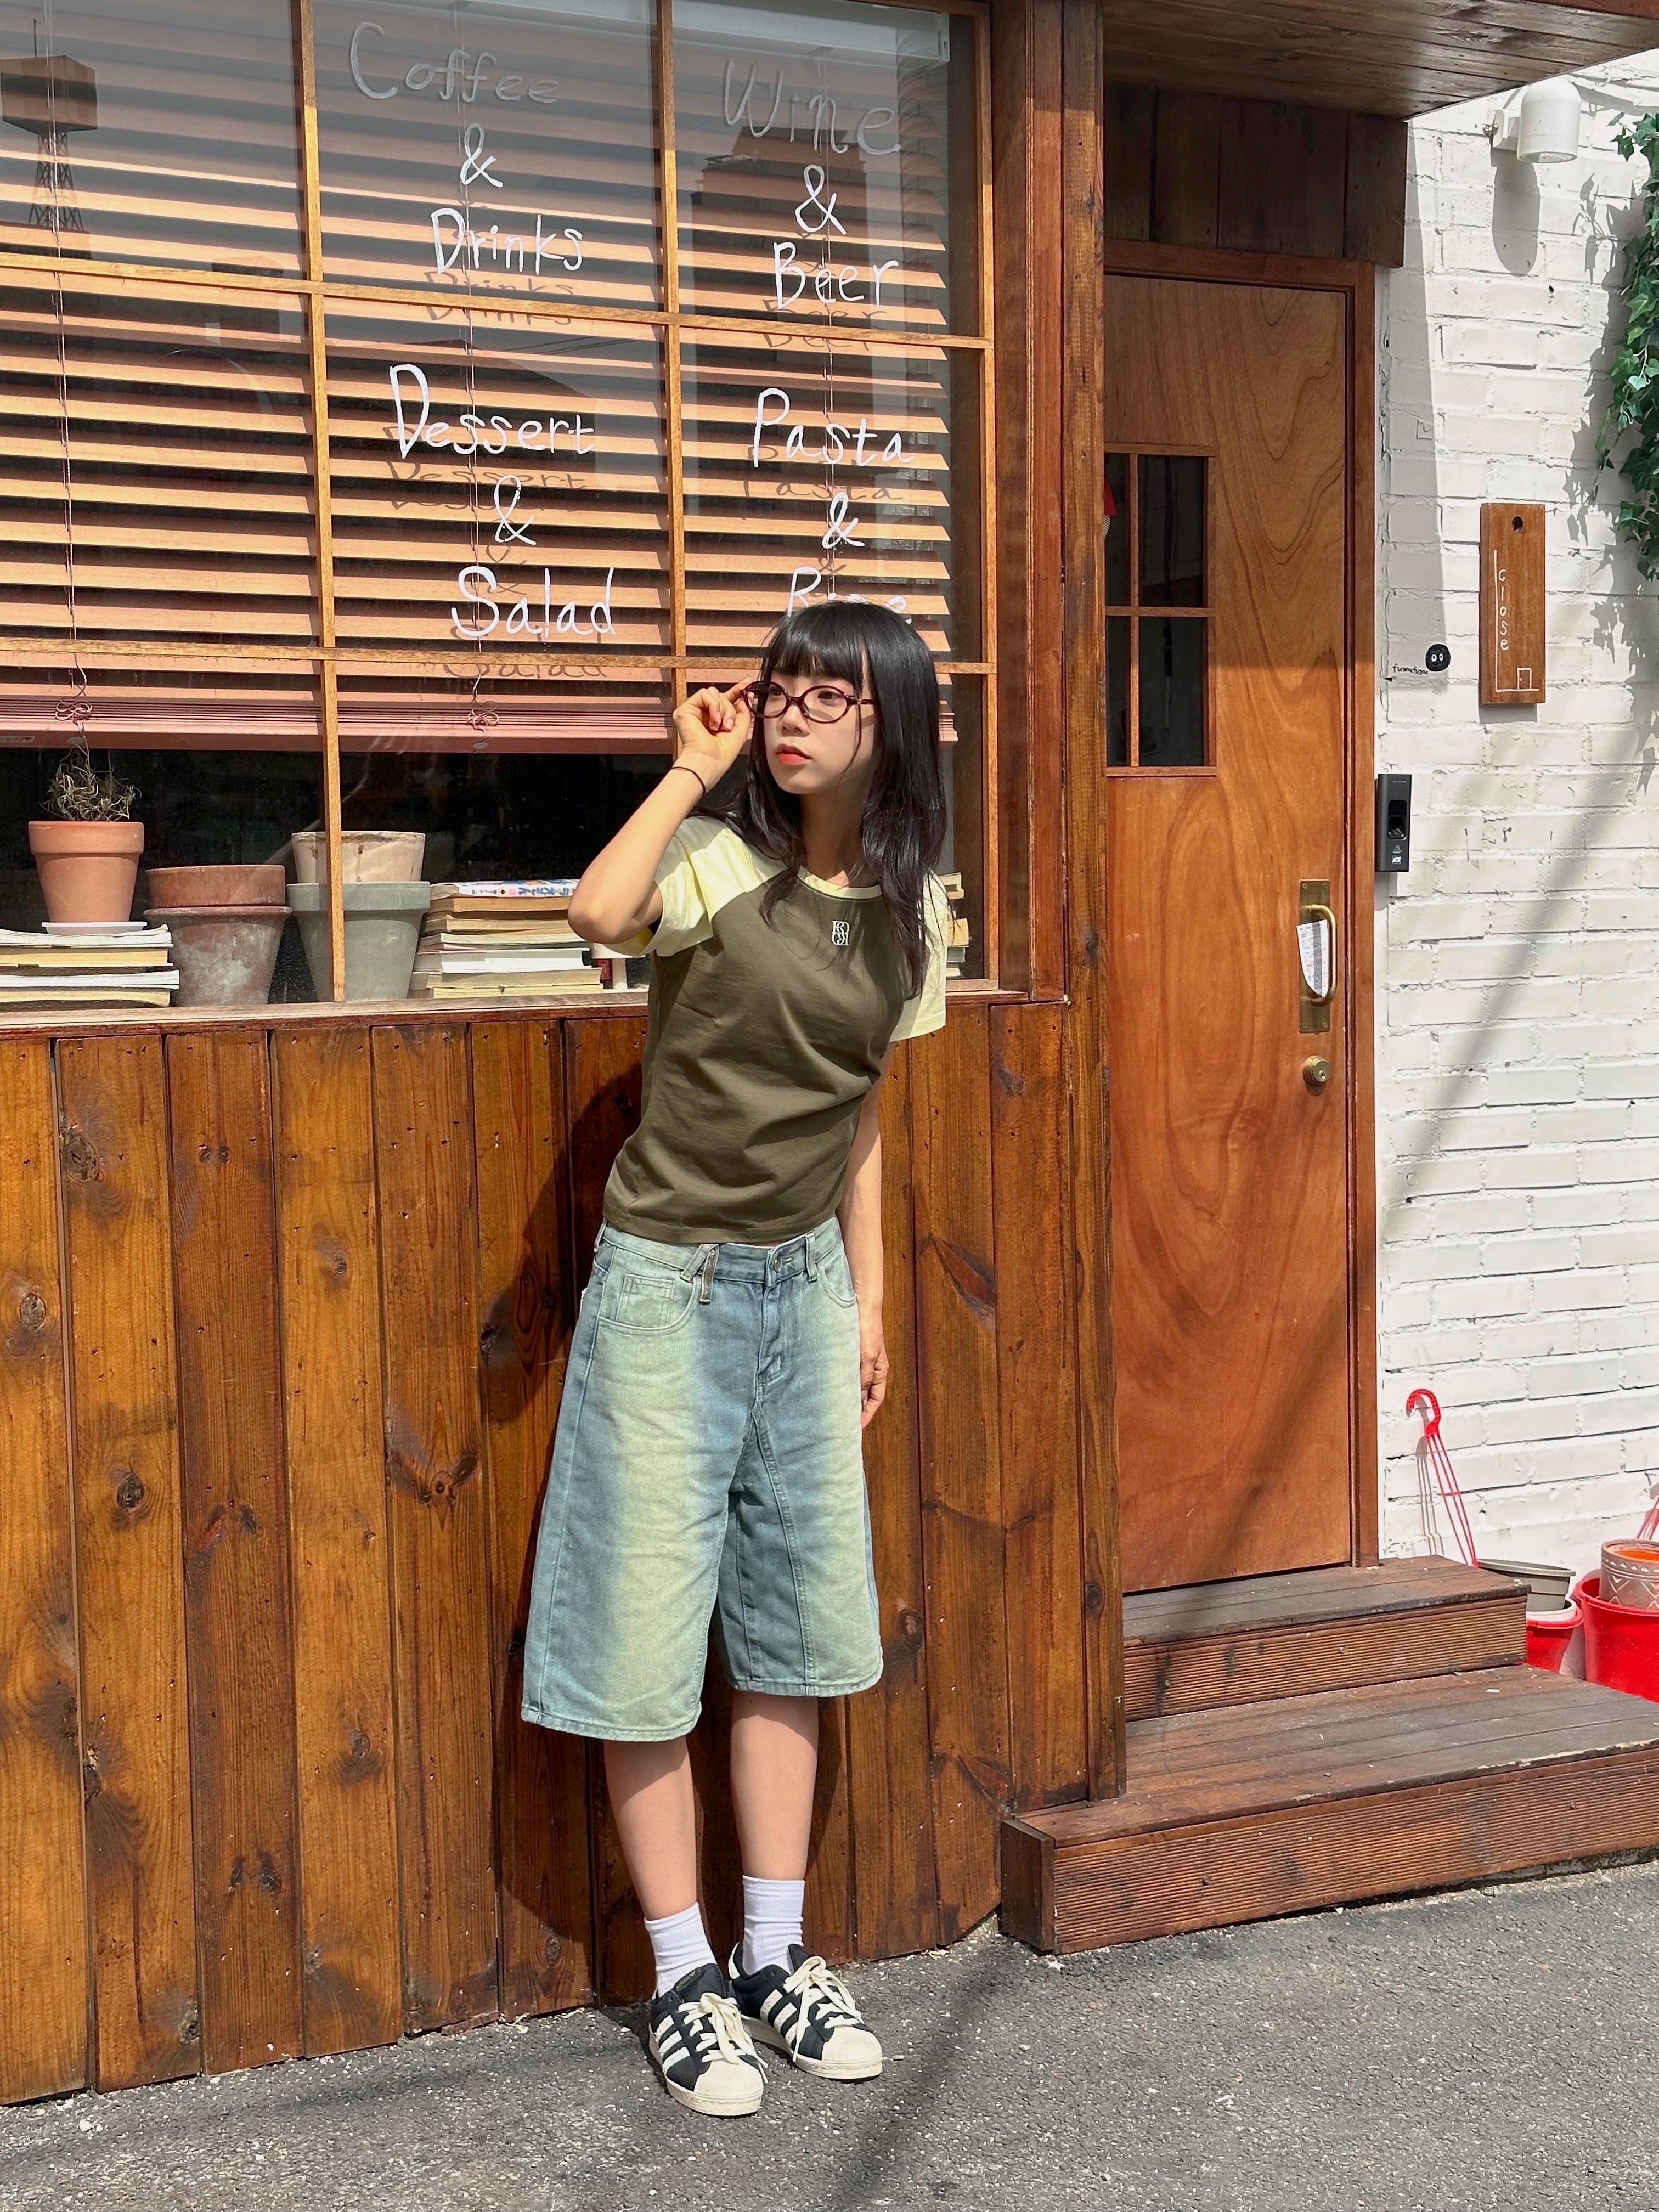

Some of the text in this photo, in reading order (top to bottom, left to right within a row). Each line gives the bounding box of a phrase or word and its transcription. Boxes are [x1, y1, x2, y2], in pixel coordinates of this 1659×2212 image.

[350, 21, 560, 104] Coffee
[724, 59, 901, 156] Wine
[460, 123, 503, 188] &
[794, 165, 847, 235] &
[430, 207, 583, 275] Drinks
[773, 241, 899, 310] Beer
[389, 363, 595, 459] Dessert
[753, 387, 915, 468] Pasta
[493, 474, 537, 546] &
[822, 492, 866, 549] &
[451, 565, 616, 639] Salad
